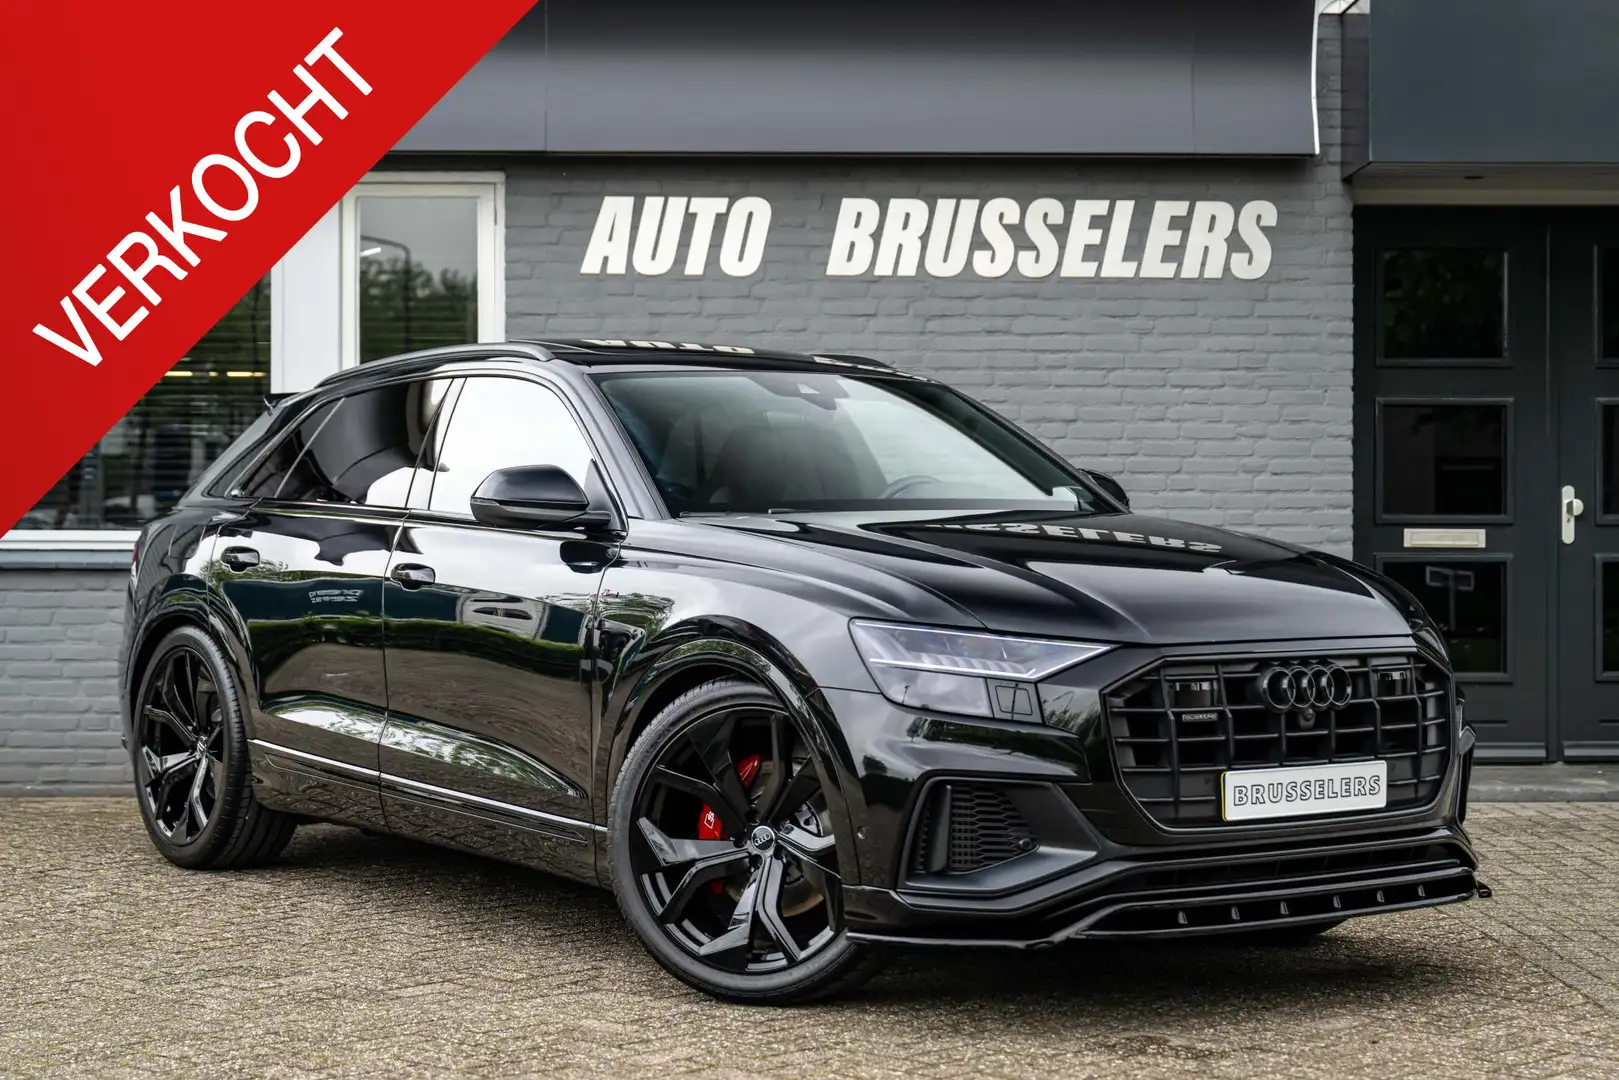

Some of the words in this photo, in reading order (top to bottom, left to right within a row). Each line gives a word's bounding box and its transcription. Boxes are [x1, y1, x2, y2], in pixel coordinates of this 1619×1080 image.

[580, 196, 772, 278] AUTO
[826, 197, 1278, 281] BRUSSELERS
[1233, 775, 1381, 807] BRUSSELERS
